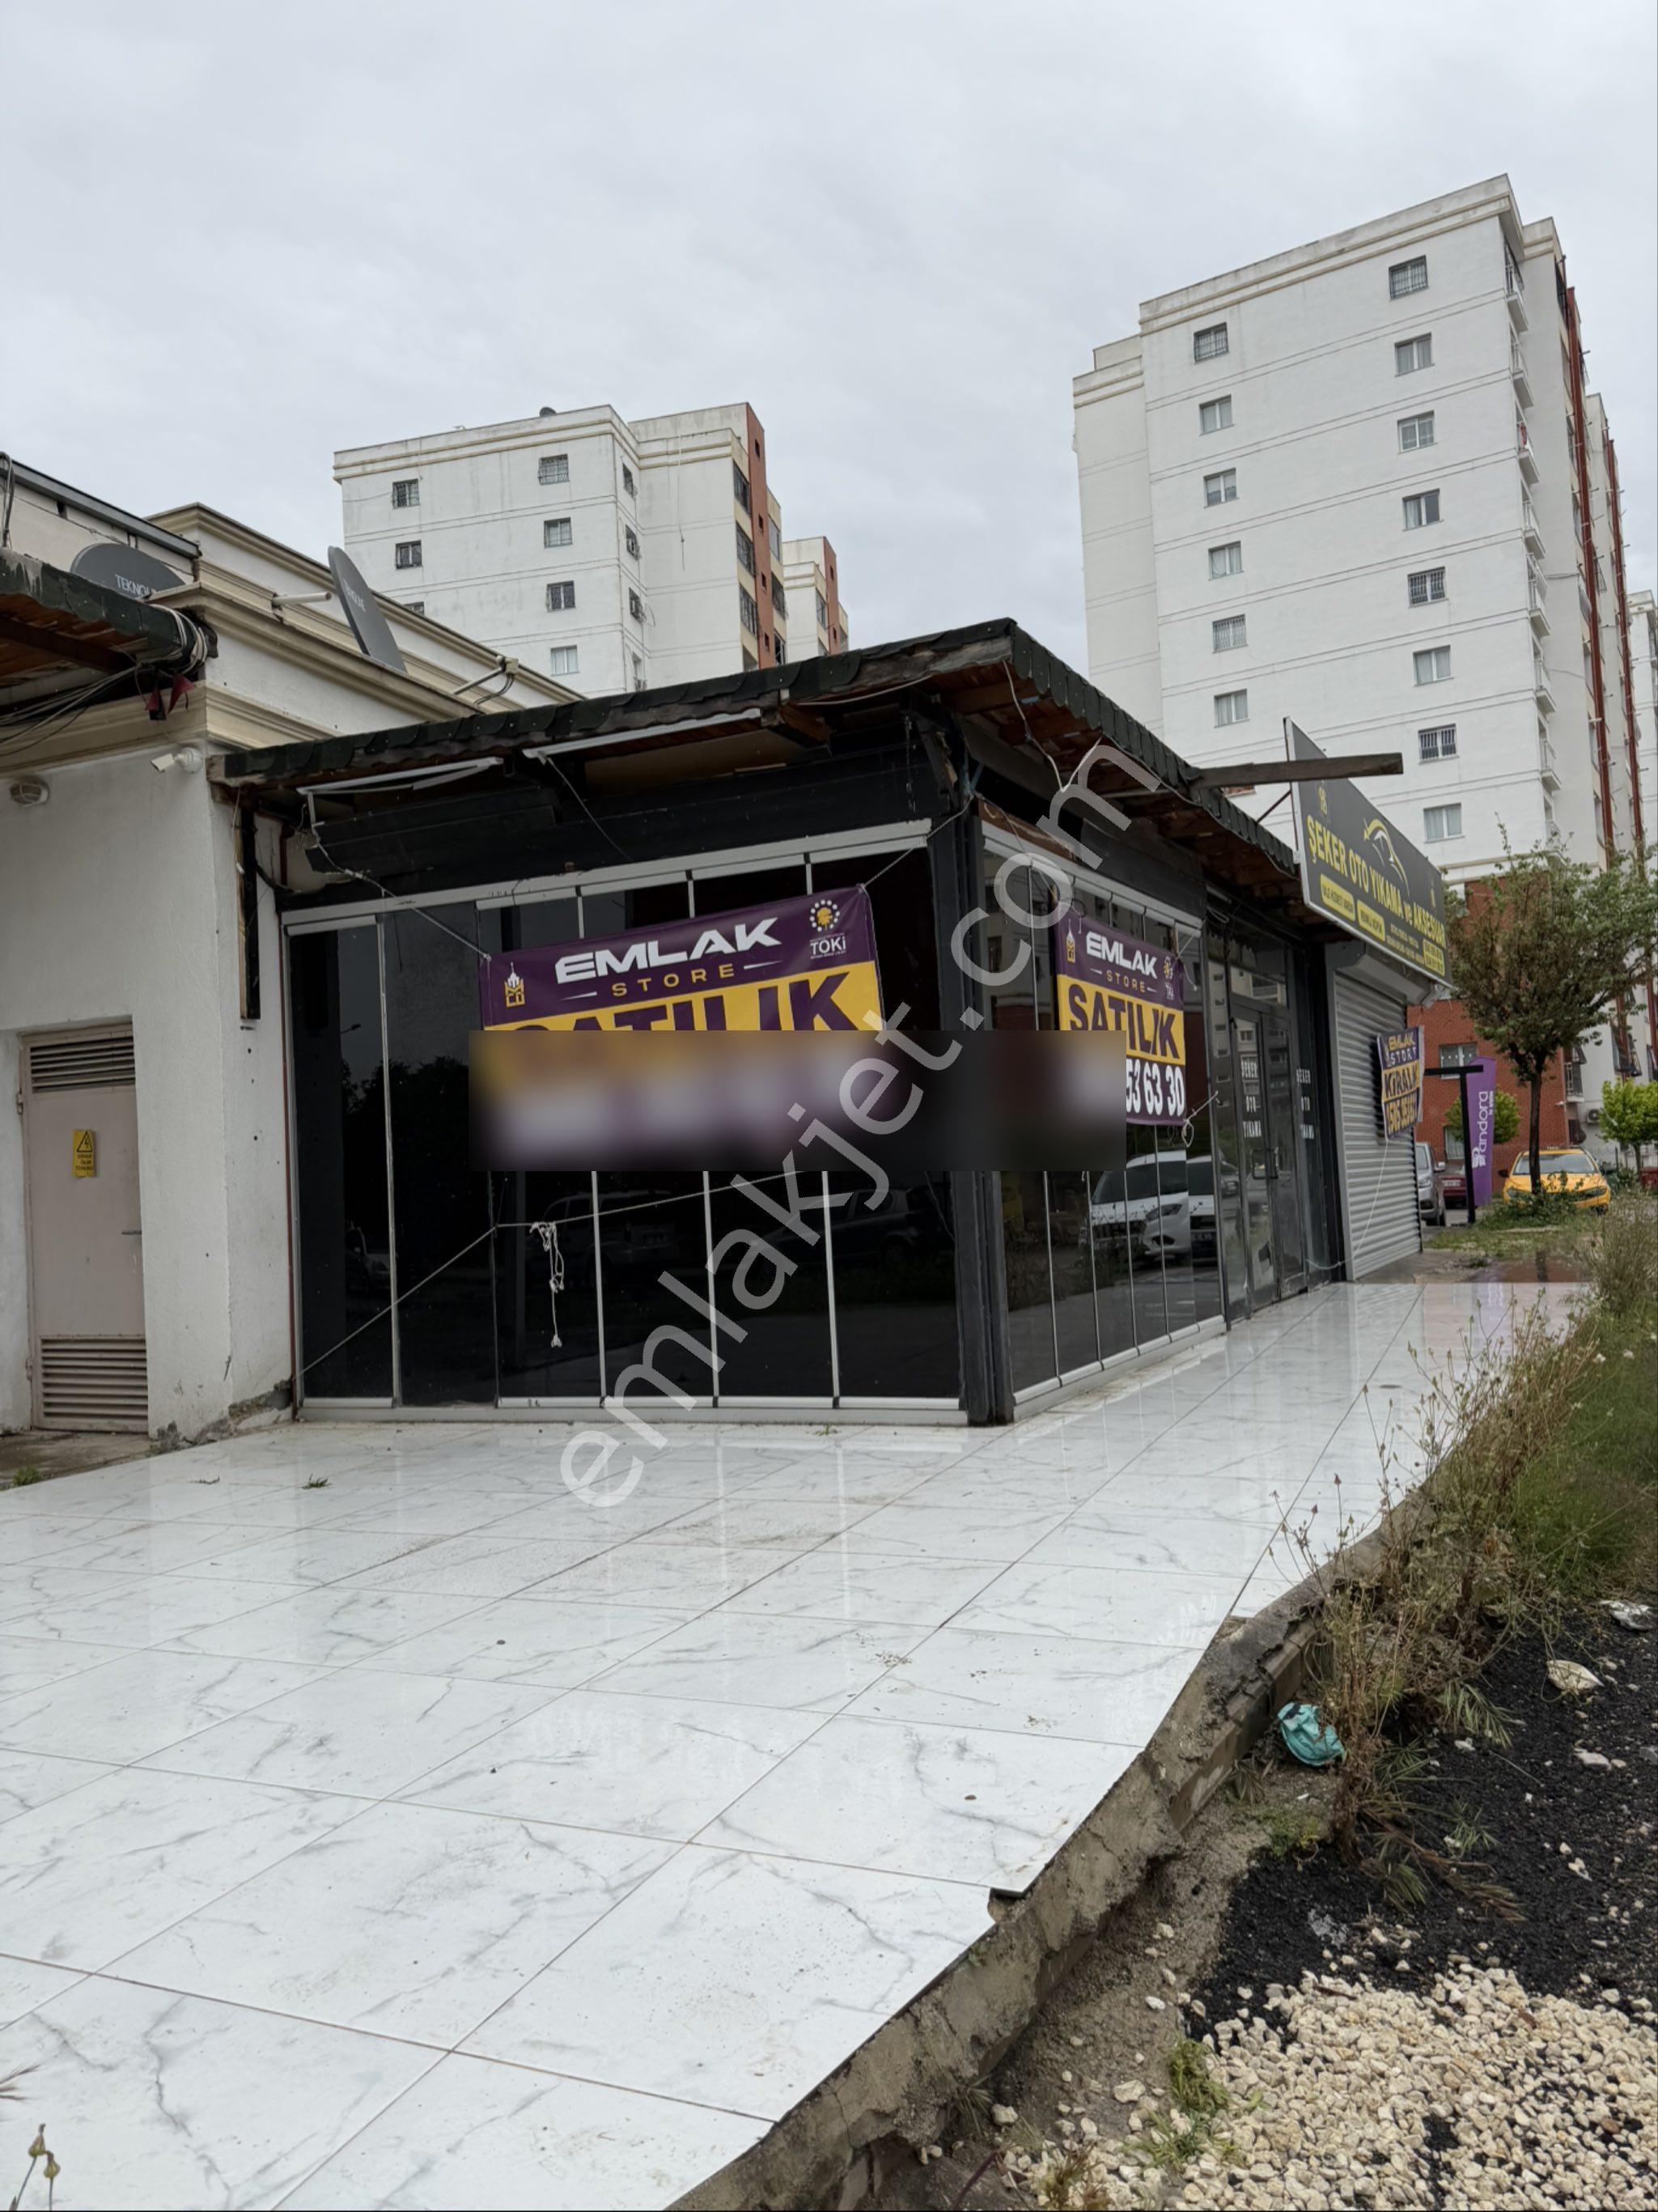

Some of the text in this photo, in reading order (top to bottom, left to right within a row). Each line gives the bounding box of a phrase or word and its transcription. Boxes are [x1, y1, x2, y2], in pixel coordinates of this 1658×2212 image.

[1306, 814, 1348, 878] ŞEKER
[1348, 849, 1369, 894] OTO
[1369, 866, 1404, 919] YIKAMA
[554, 917, 782, 984] EMLAK
[611, 963, 735, 996] STORE
[1086, 931, 1158, 979] EMLAK
[1106, 969, 1146, 993] STORE
[1068, 983, 1181, 1059] SATILIK
[1143, 1061, 1163, 1116] 63
[1165, 1064, 1185, 1118] 30
[1472, 1091, 1489, 1169] Pandora
